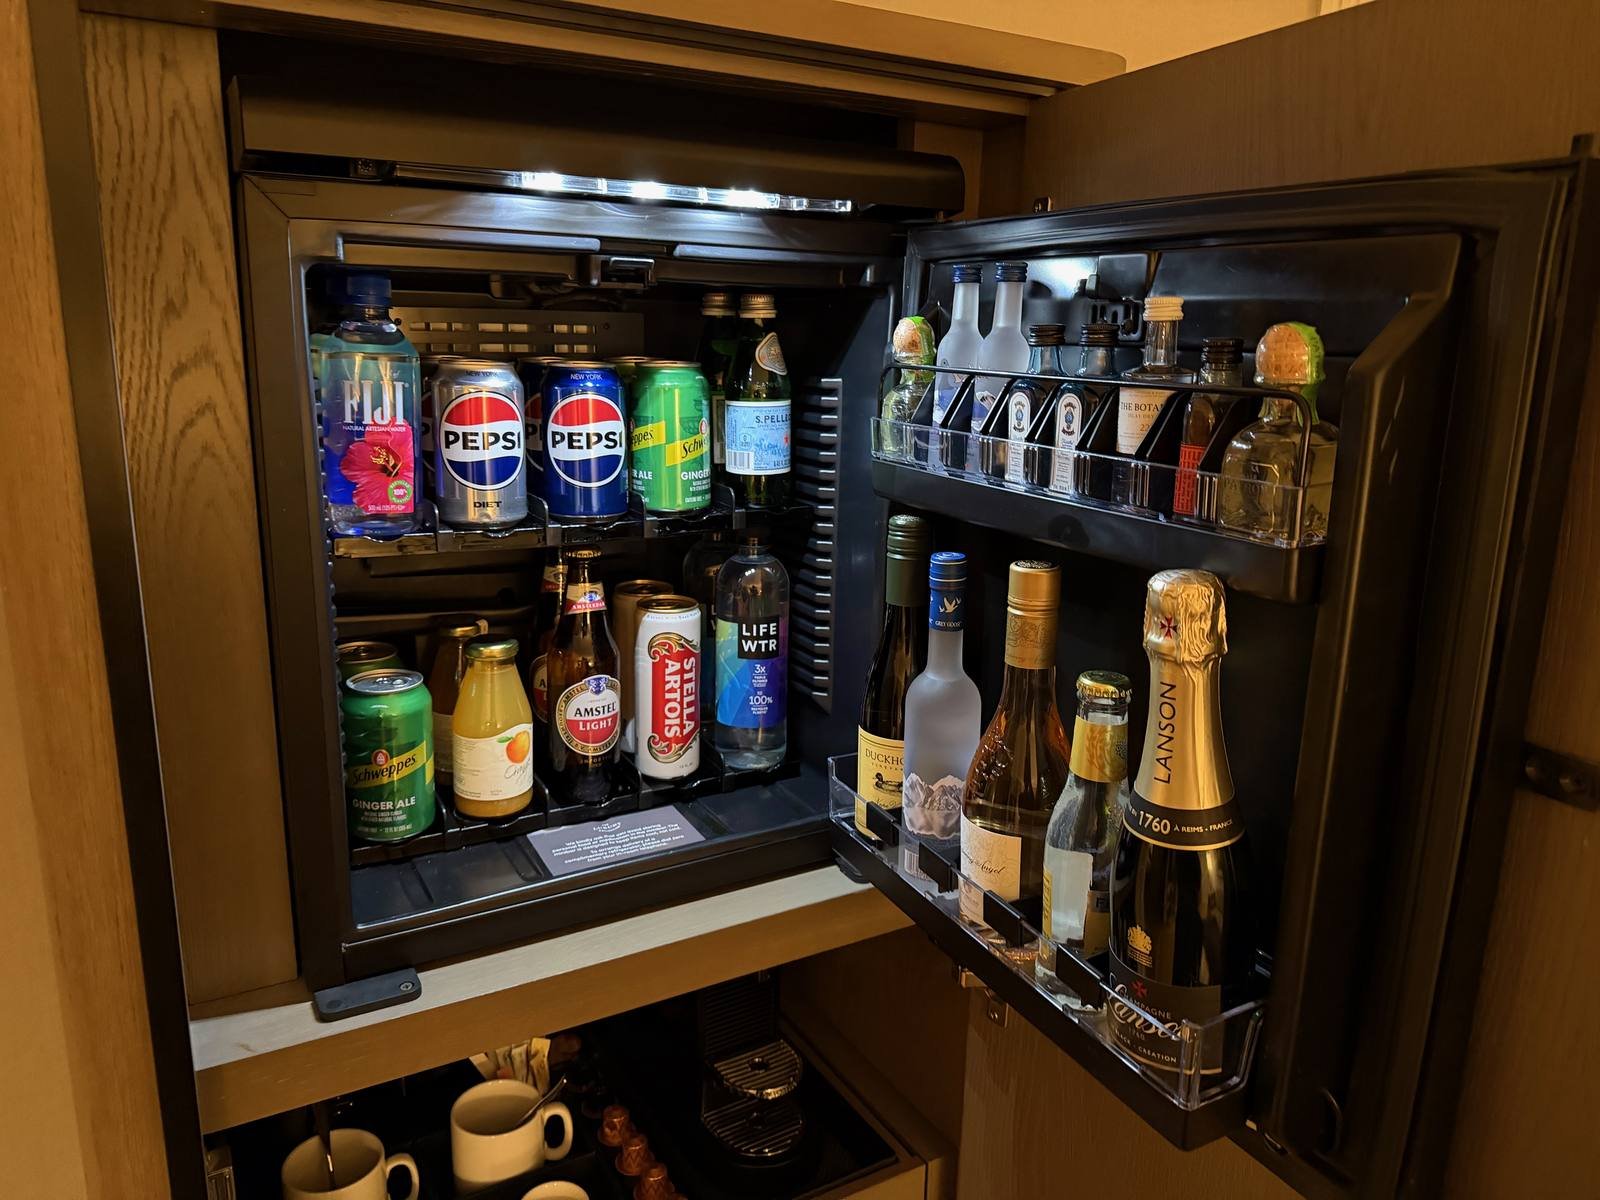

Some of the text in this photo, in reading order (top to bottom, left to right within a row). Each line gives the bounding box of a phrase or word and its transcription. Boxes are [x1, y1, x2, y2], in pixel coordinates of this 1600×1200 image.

[1121, 402, 1133, 411] THE
[444, 430, 521, 451] PEPSI
[551, 430, 623, 450] PEPSI
[638, 471, 653, 480] ALE
[473, 501, 502, 509] DIET
[742, 622, 777, 637] LIFE
[742, 639, 777, 652] WTR
[754, 664, 766, 674] 3x
[664, 658, 681, 738] ARTOIS
[683, 657, 696, 736] STELLA
[749, 695, 773, 705] 100%
[574, 702, 617, 717] AMSTEL
[579, 718, 612, 731] LIGHT
[1153, 681, 1177, 785] LANSON
[352, 753, 417, 784] Schweppes
[352, 796, 416, 810] GINGER ALE
[1139, 810, 1171, 835] 1760
[1181, 825, 1204, 833] REIMS
[1138, 1047, 1177, 1063] CREATION
